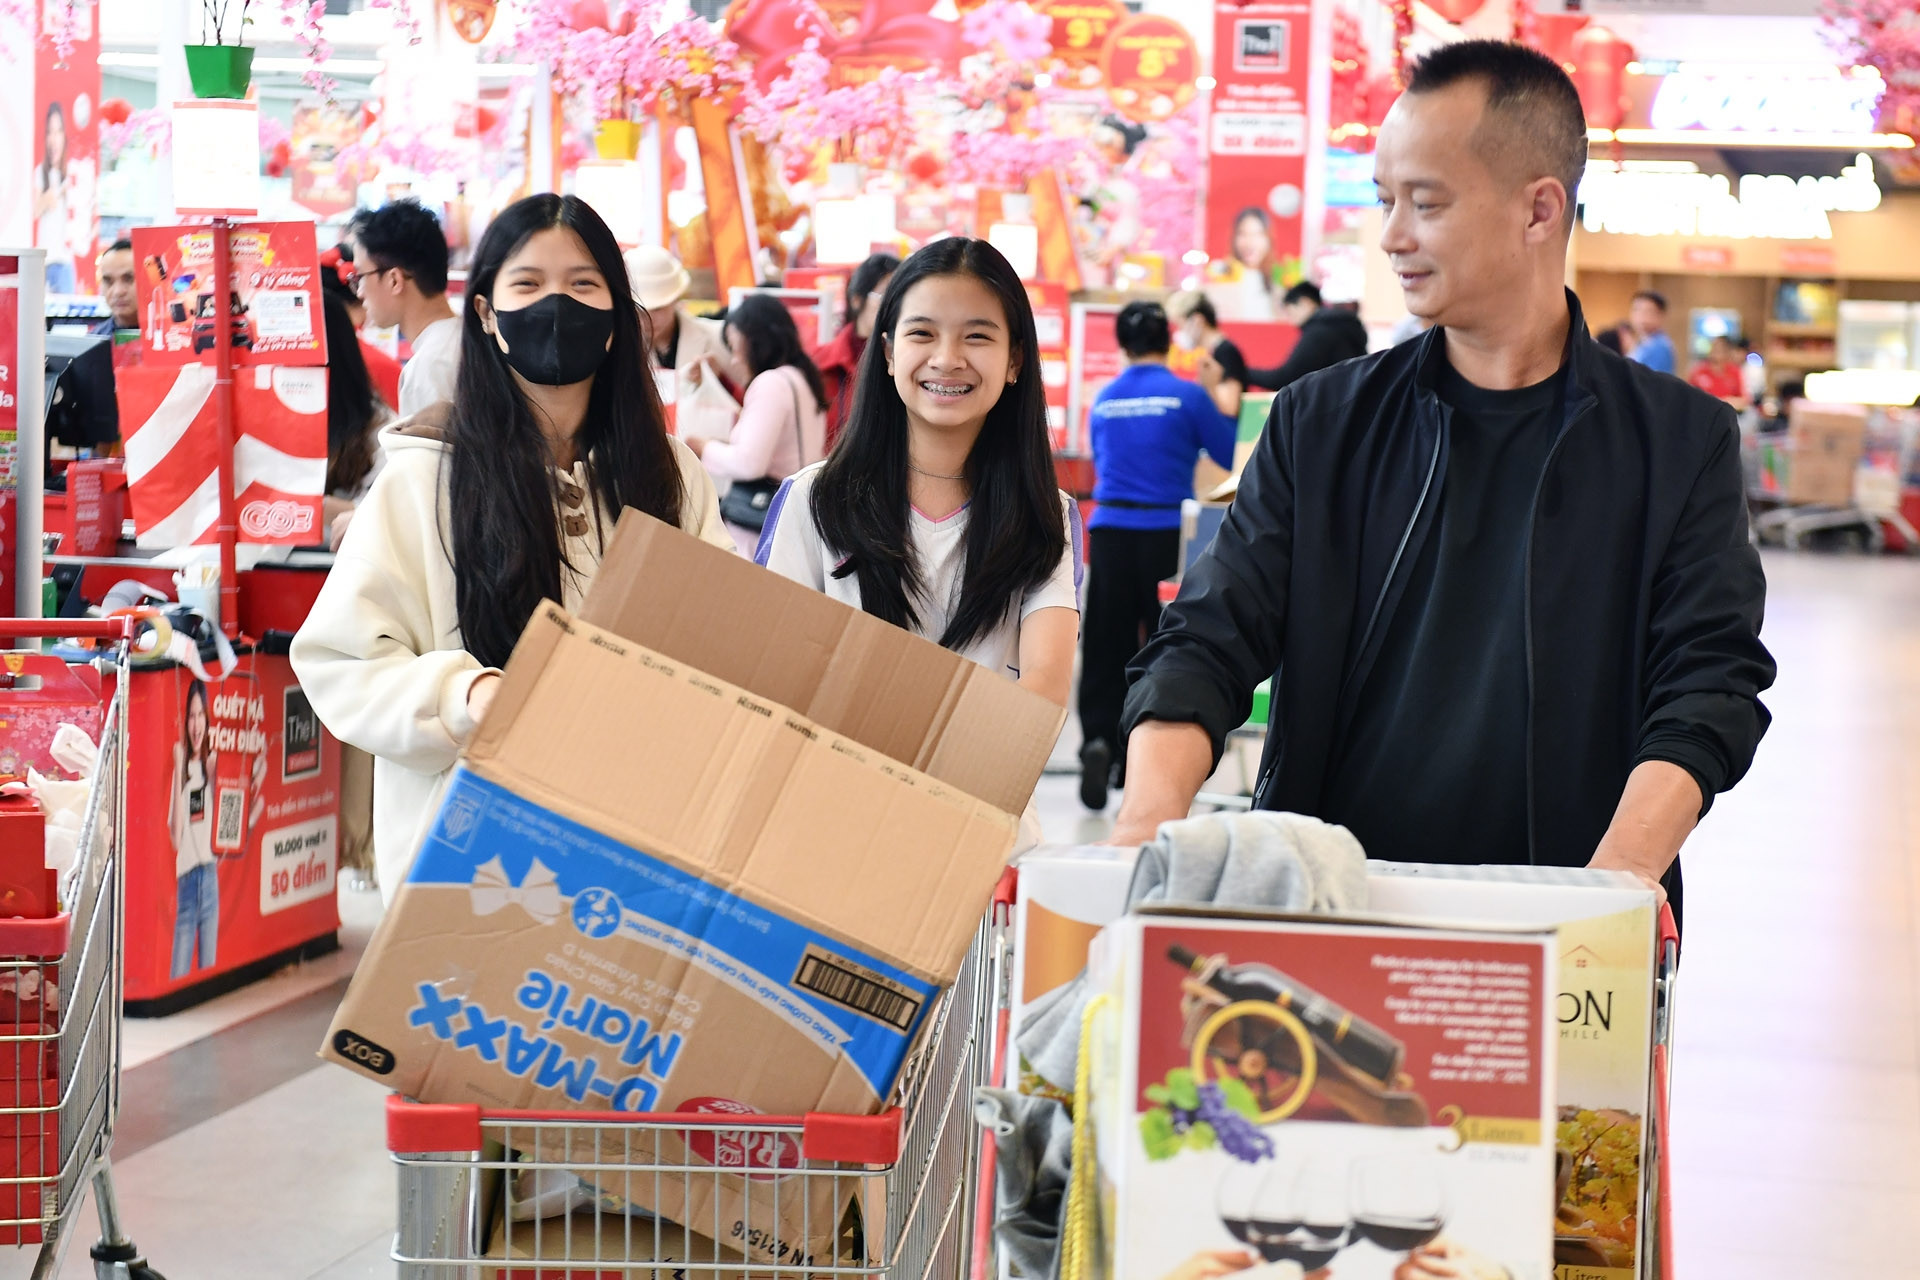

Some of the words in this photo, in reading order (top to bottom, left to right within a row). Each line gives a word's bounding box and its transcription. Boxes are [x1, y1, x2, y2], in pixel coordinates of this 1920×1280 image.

[271, 868, 290, 898] 50
[341, 1037, 386, 1066] BOX
[408, 982, 659, 1112] D-MAXX
[1436, 1105, 1467, 1153] 3
